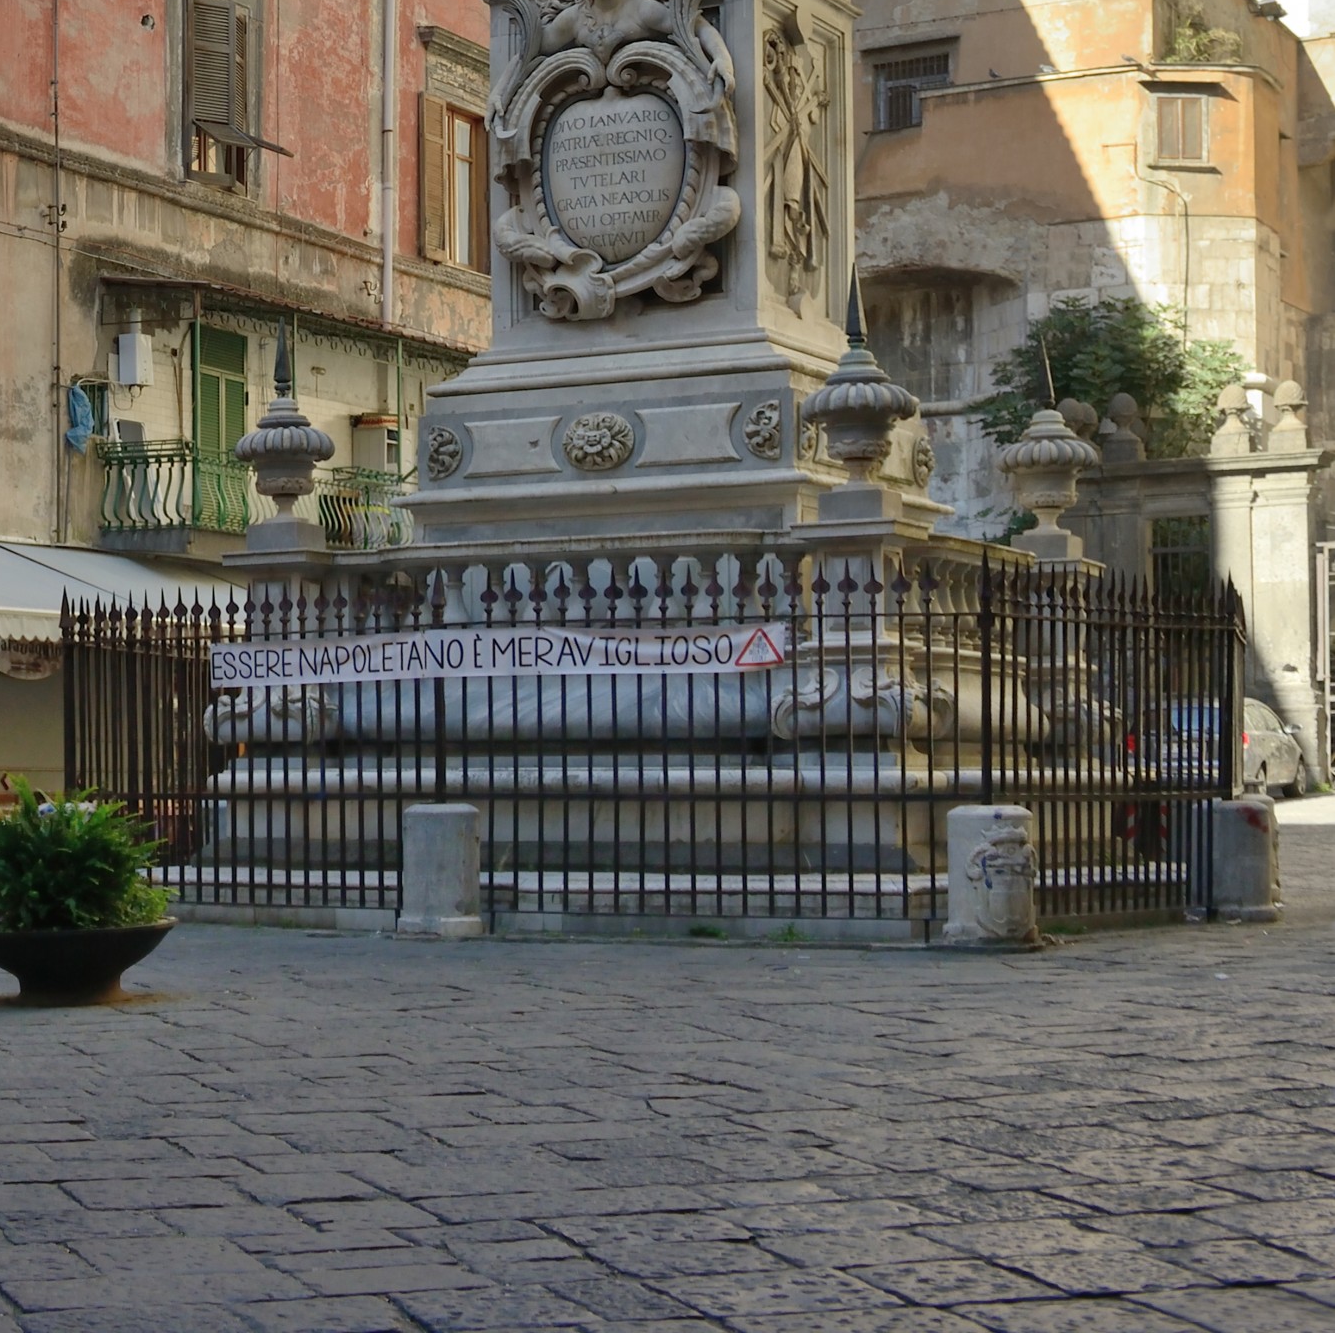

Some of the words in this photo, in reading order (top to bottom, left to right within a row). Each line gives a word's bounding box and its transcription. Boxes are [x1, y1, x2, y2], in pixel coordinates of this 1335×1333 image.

[553, 117, 586, 135] DIVO
[570, 169, 647, 190] TVTELARI
[557, 195, 598, 213] GRATA
[601, 188, 670, 207] NEAPOLIS
[567, 215, 596, 231] CIVI
[211, 648, 293, 681] ESSERE
[299, 638, 464, 677] NAPOLETANO
[473, 633, 483, 669] È
[492, 633, 733, 668] MERAVIGLIOSO
